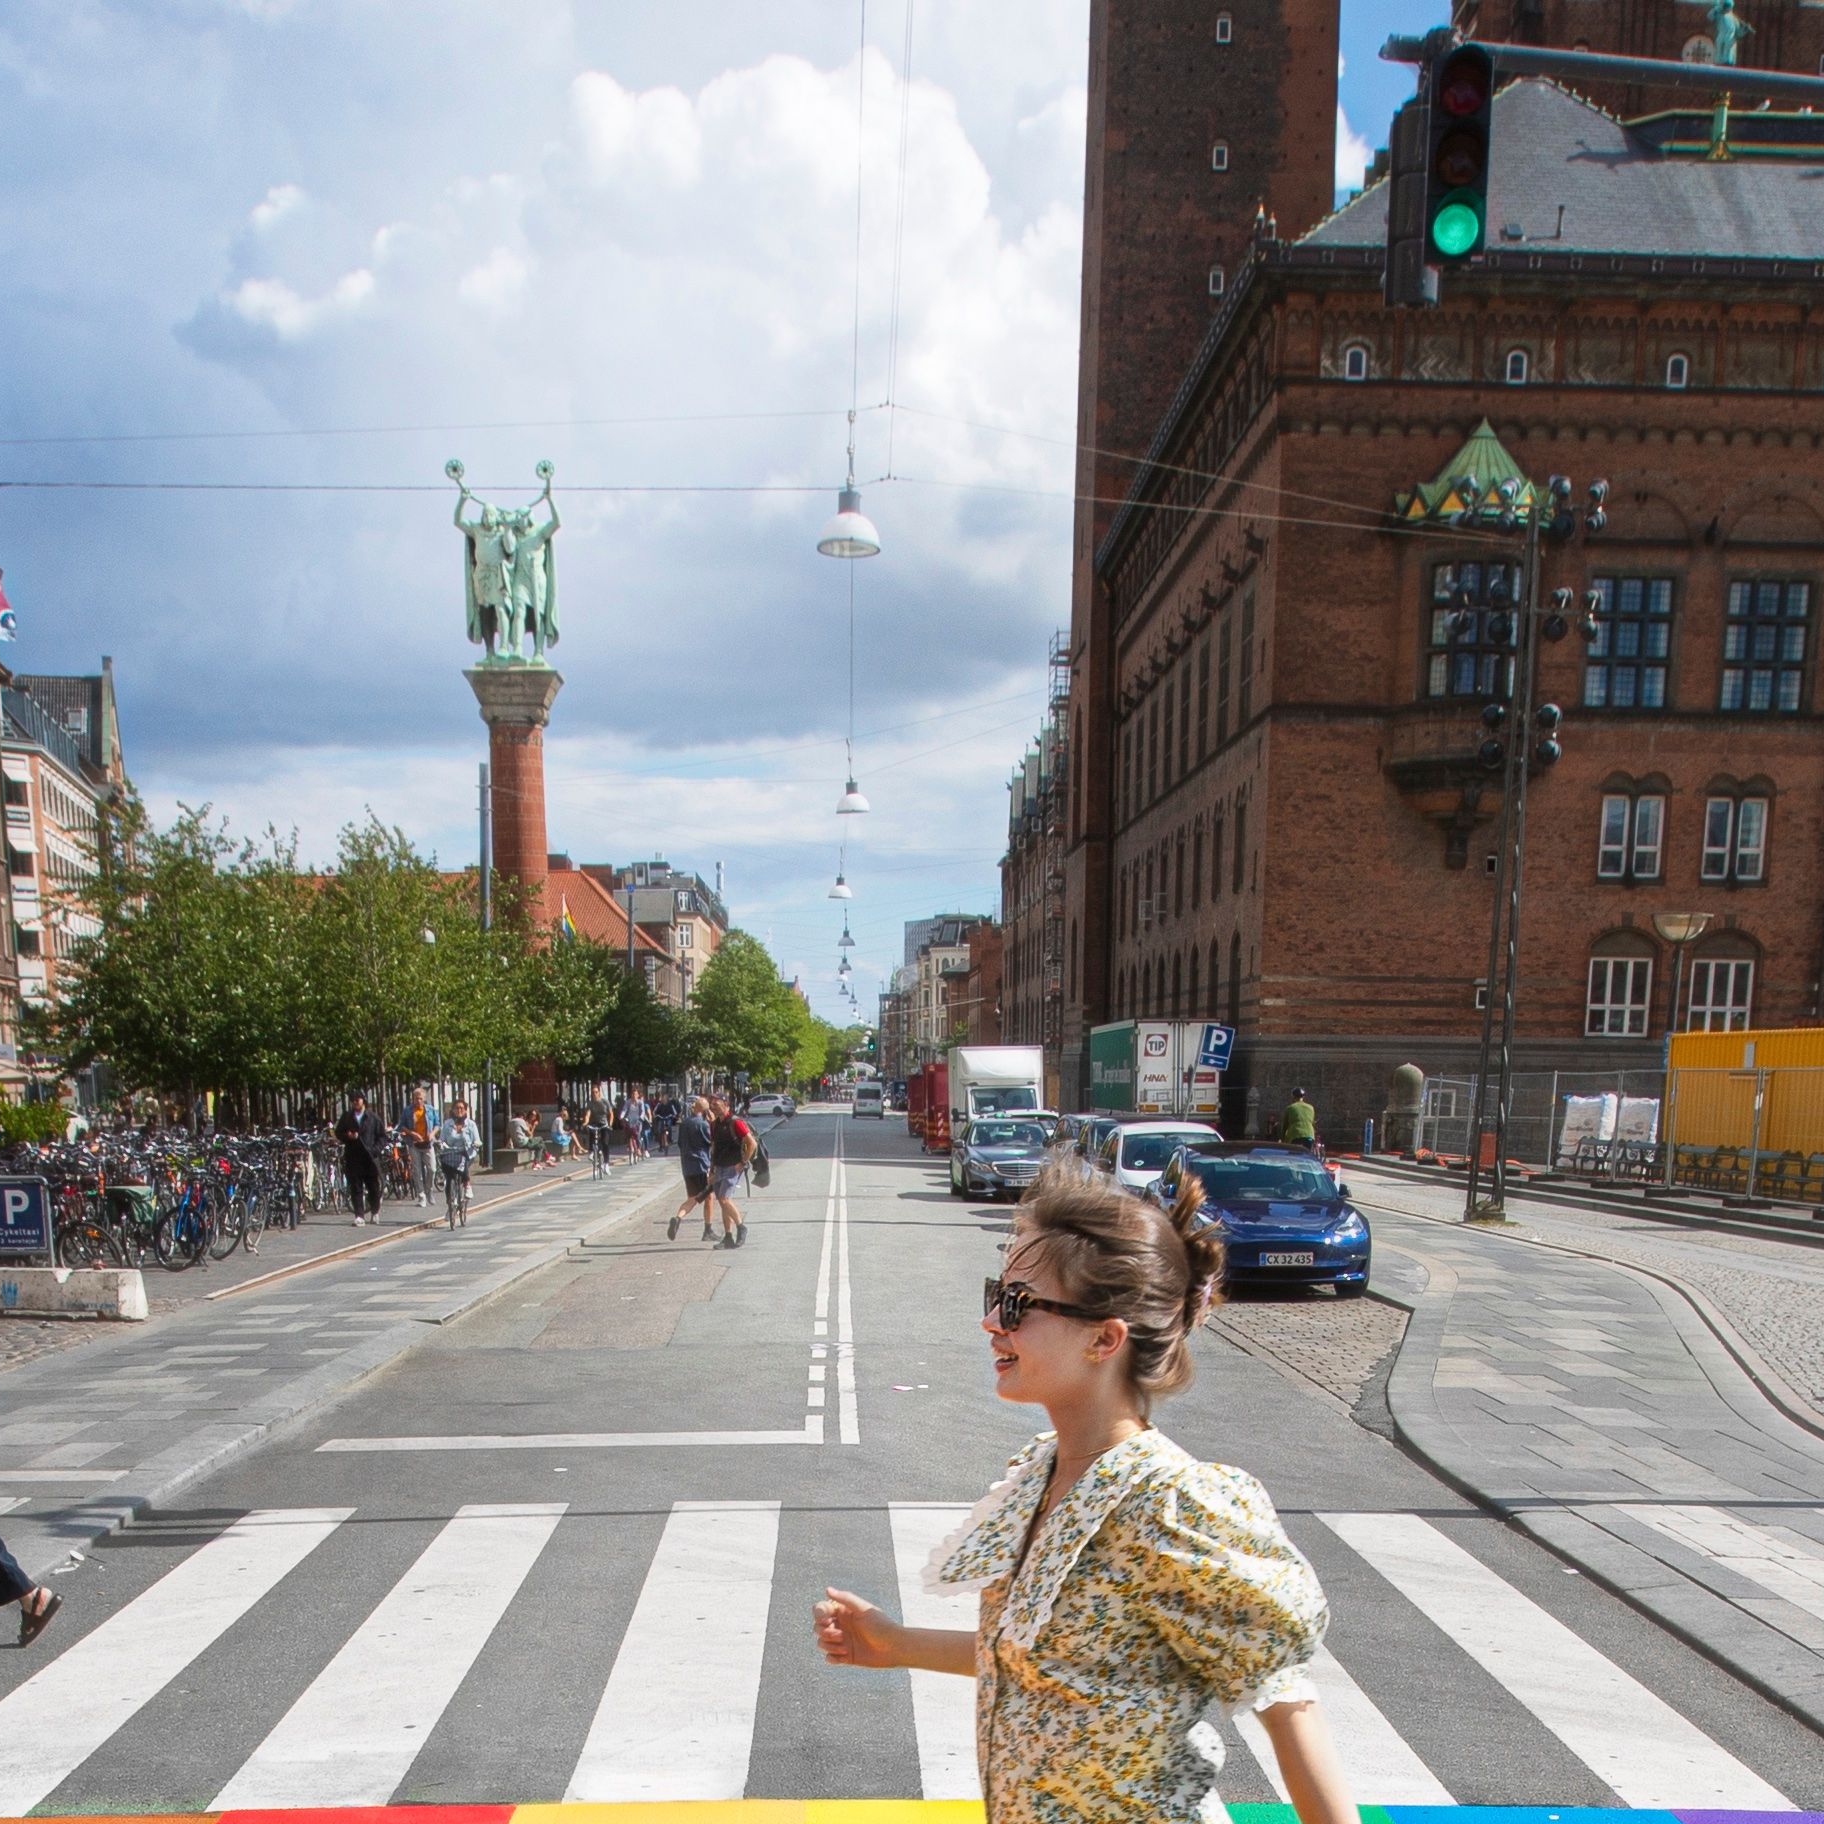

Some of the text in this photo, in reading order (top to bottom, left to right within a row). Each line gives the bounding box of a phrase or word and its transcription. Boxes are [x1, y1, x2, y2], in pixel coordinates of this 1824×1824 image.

[1148, 1040, 1165, 1051] TIP
[1209, 1029, 1228, 1053] P
[3, 1189, 30, 1225] P
[1267, 1255, 1312, 1265] CX 32 435
